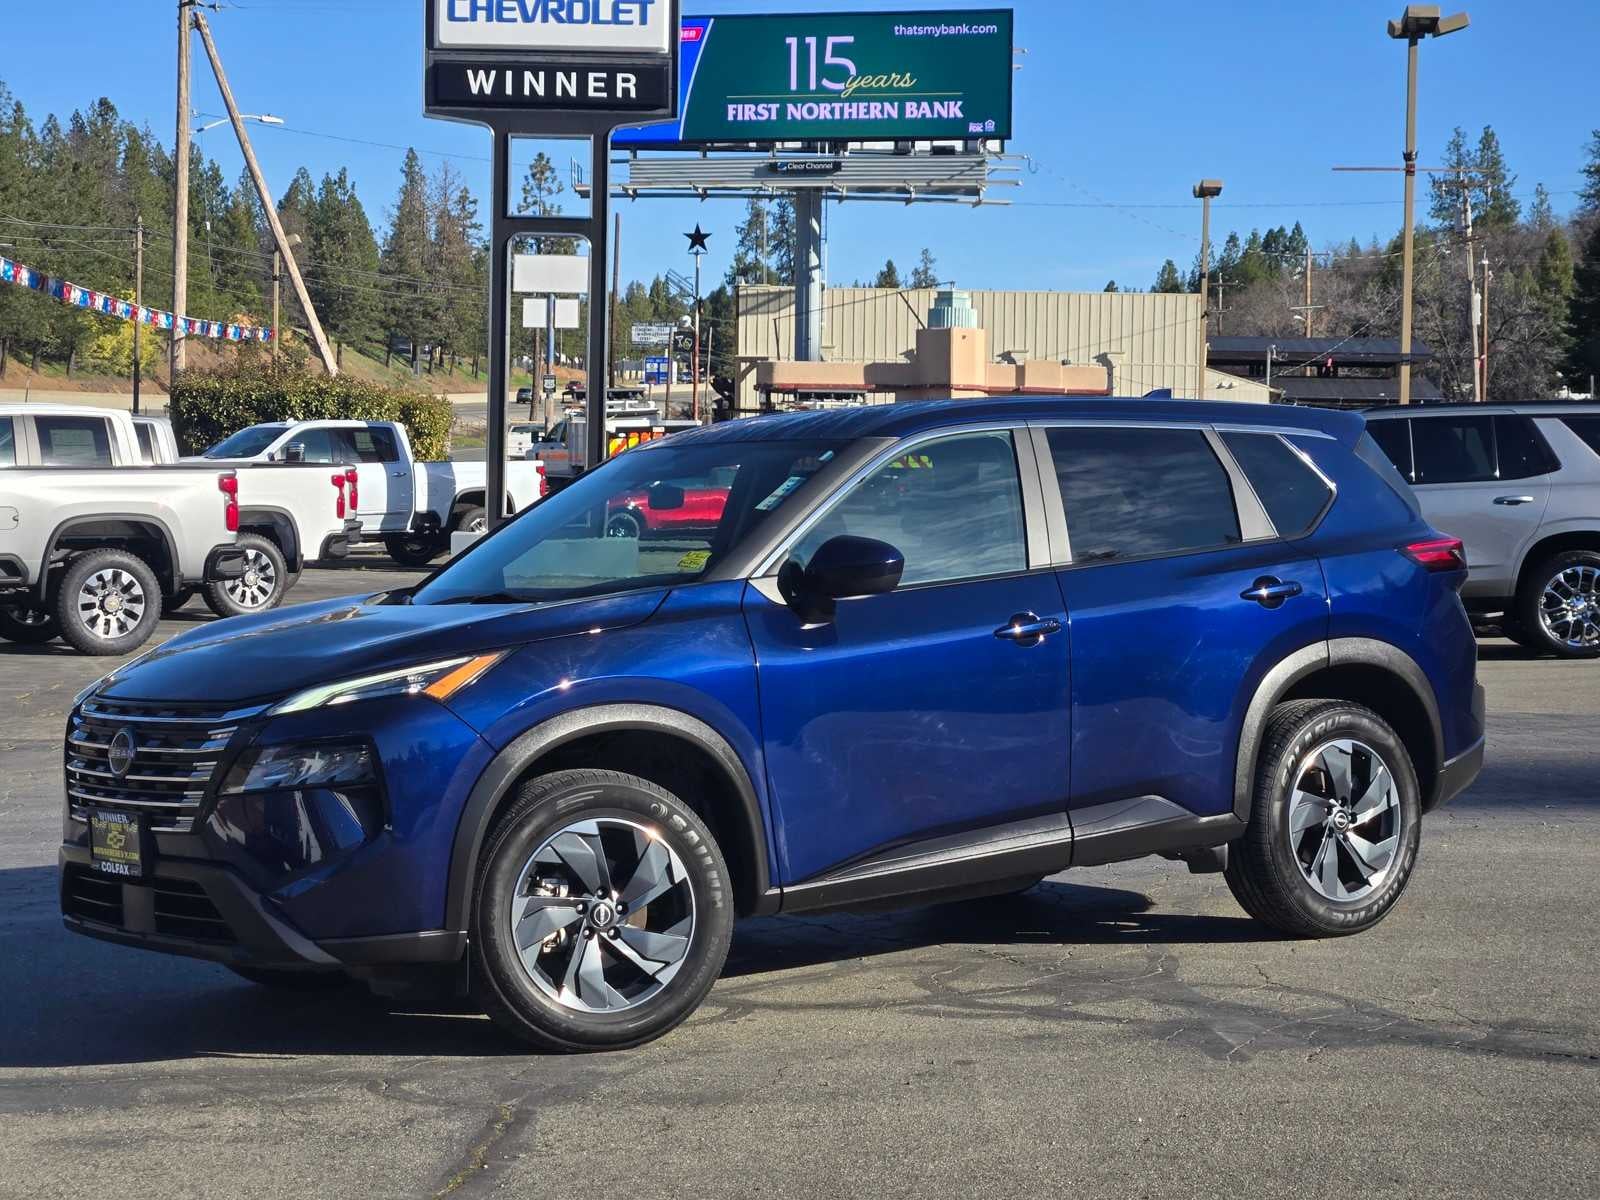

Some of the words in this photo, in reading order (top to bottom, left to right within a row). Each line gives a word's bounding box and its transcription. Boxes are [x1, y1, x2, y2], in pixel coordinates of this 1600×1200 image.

[446, 0, 651, 25] CHEVROLET
[894, 23, 998, 37] thatsmybank.com
[785, 35, 857, 92] 115
[840, 70, 917, 98] years
[467, 69, 637, 98] WINNER
[727, 103, 780, 121] FIRST
[787, 101, 899, 121] NORTHERN
[905, 100, 964, 119] BANK
[787, 161, 805, 169] Clear
[97, 811, 129, 824] WINNER
[101, 861, 130, 875] COLFAX
[668, 814, 723, 909] SAILUN
